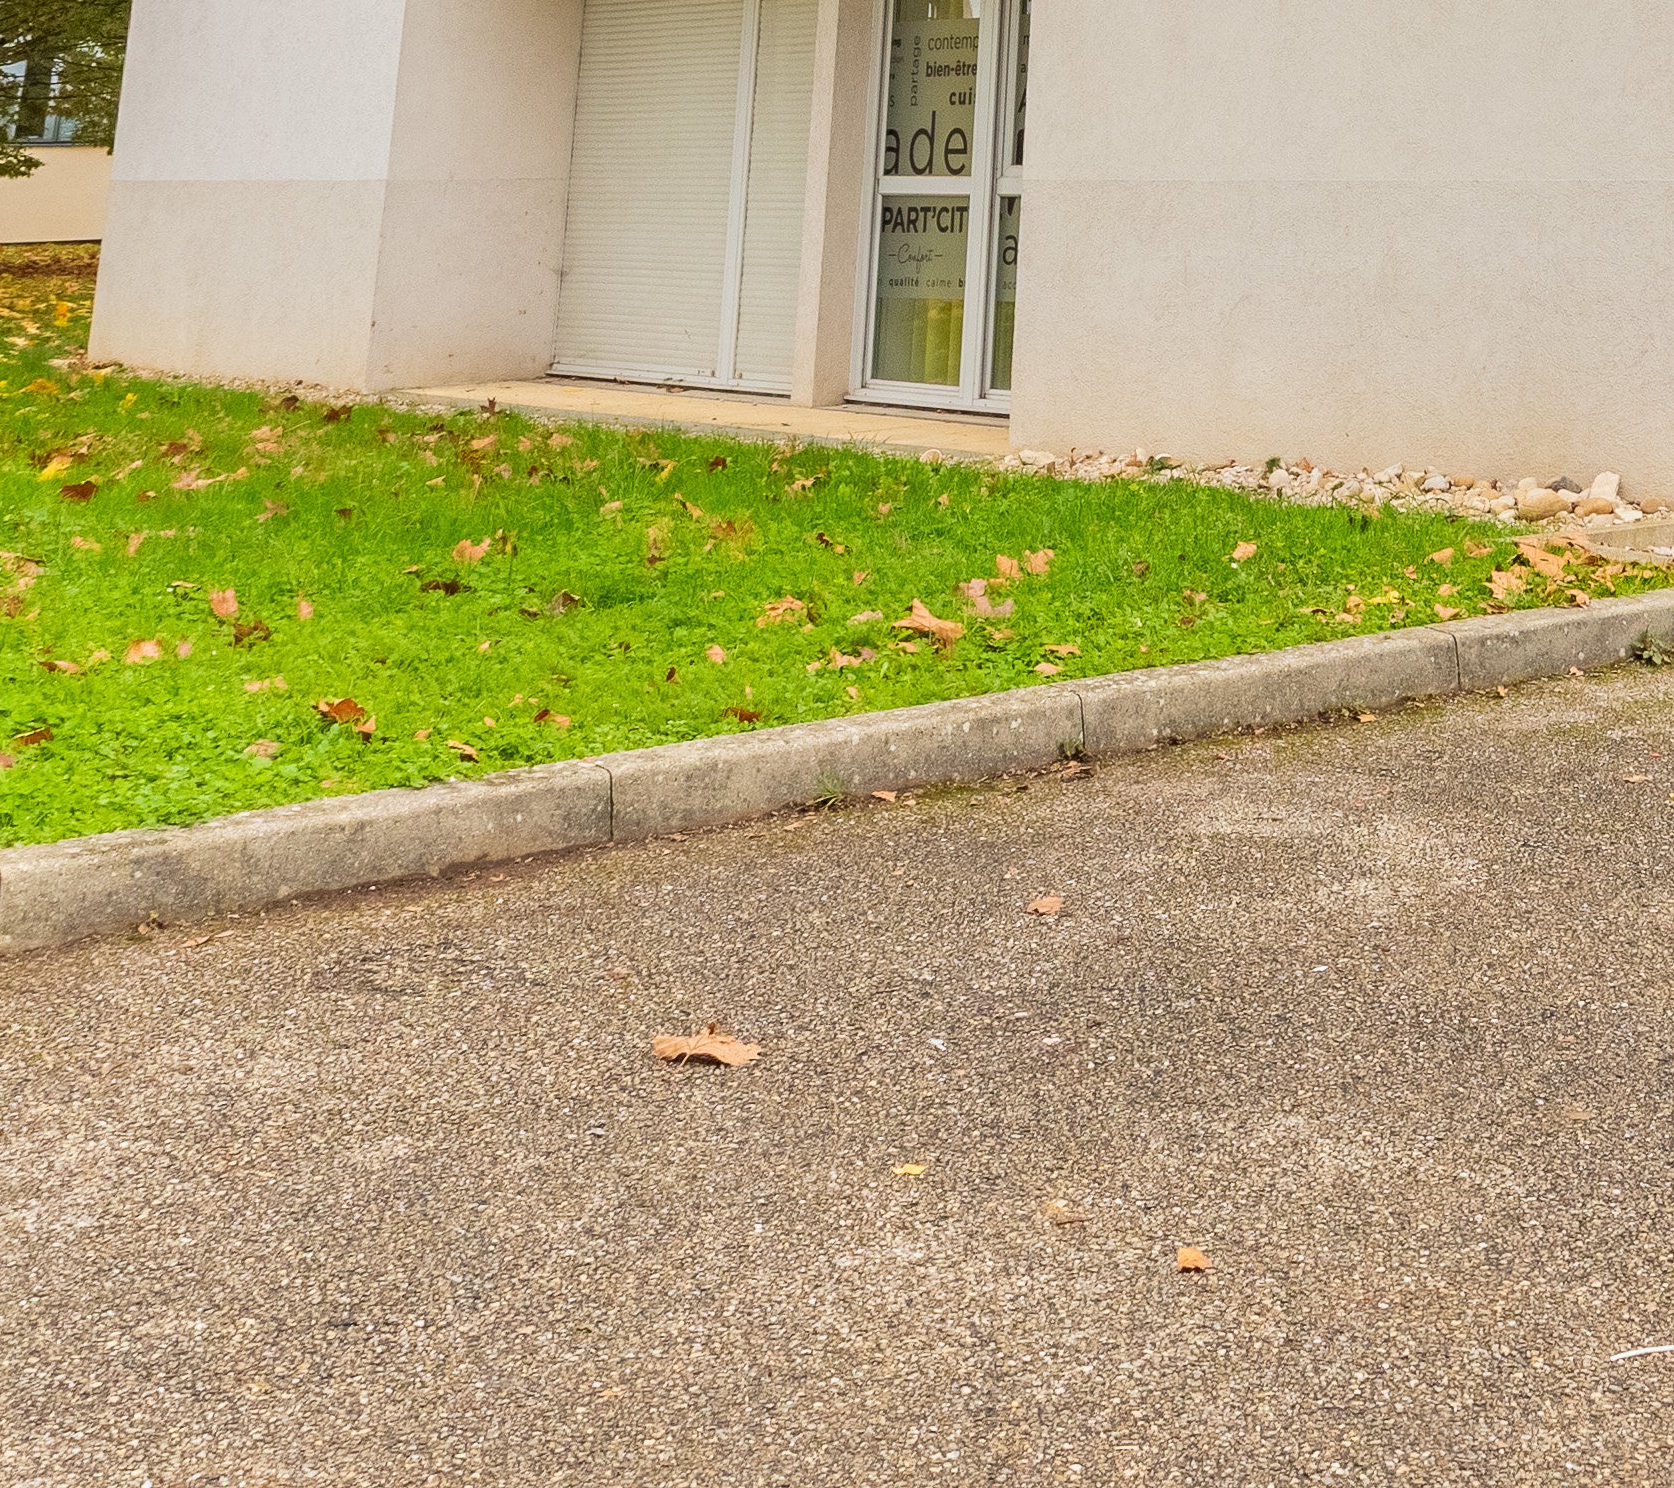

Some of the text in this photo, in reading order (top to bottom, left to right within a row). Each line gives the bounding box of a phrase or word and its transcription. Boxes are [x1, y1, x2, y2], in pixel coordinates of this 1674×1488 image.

[910, 35, 922, 107] partage
[926, 60, 977, 77] bien-être
[888, 276, 920, 288] qualité
[926, 277, 951, 288] calme
